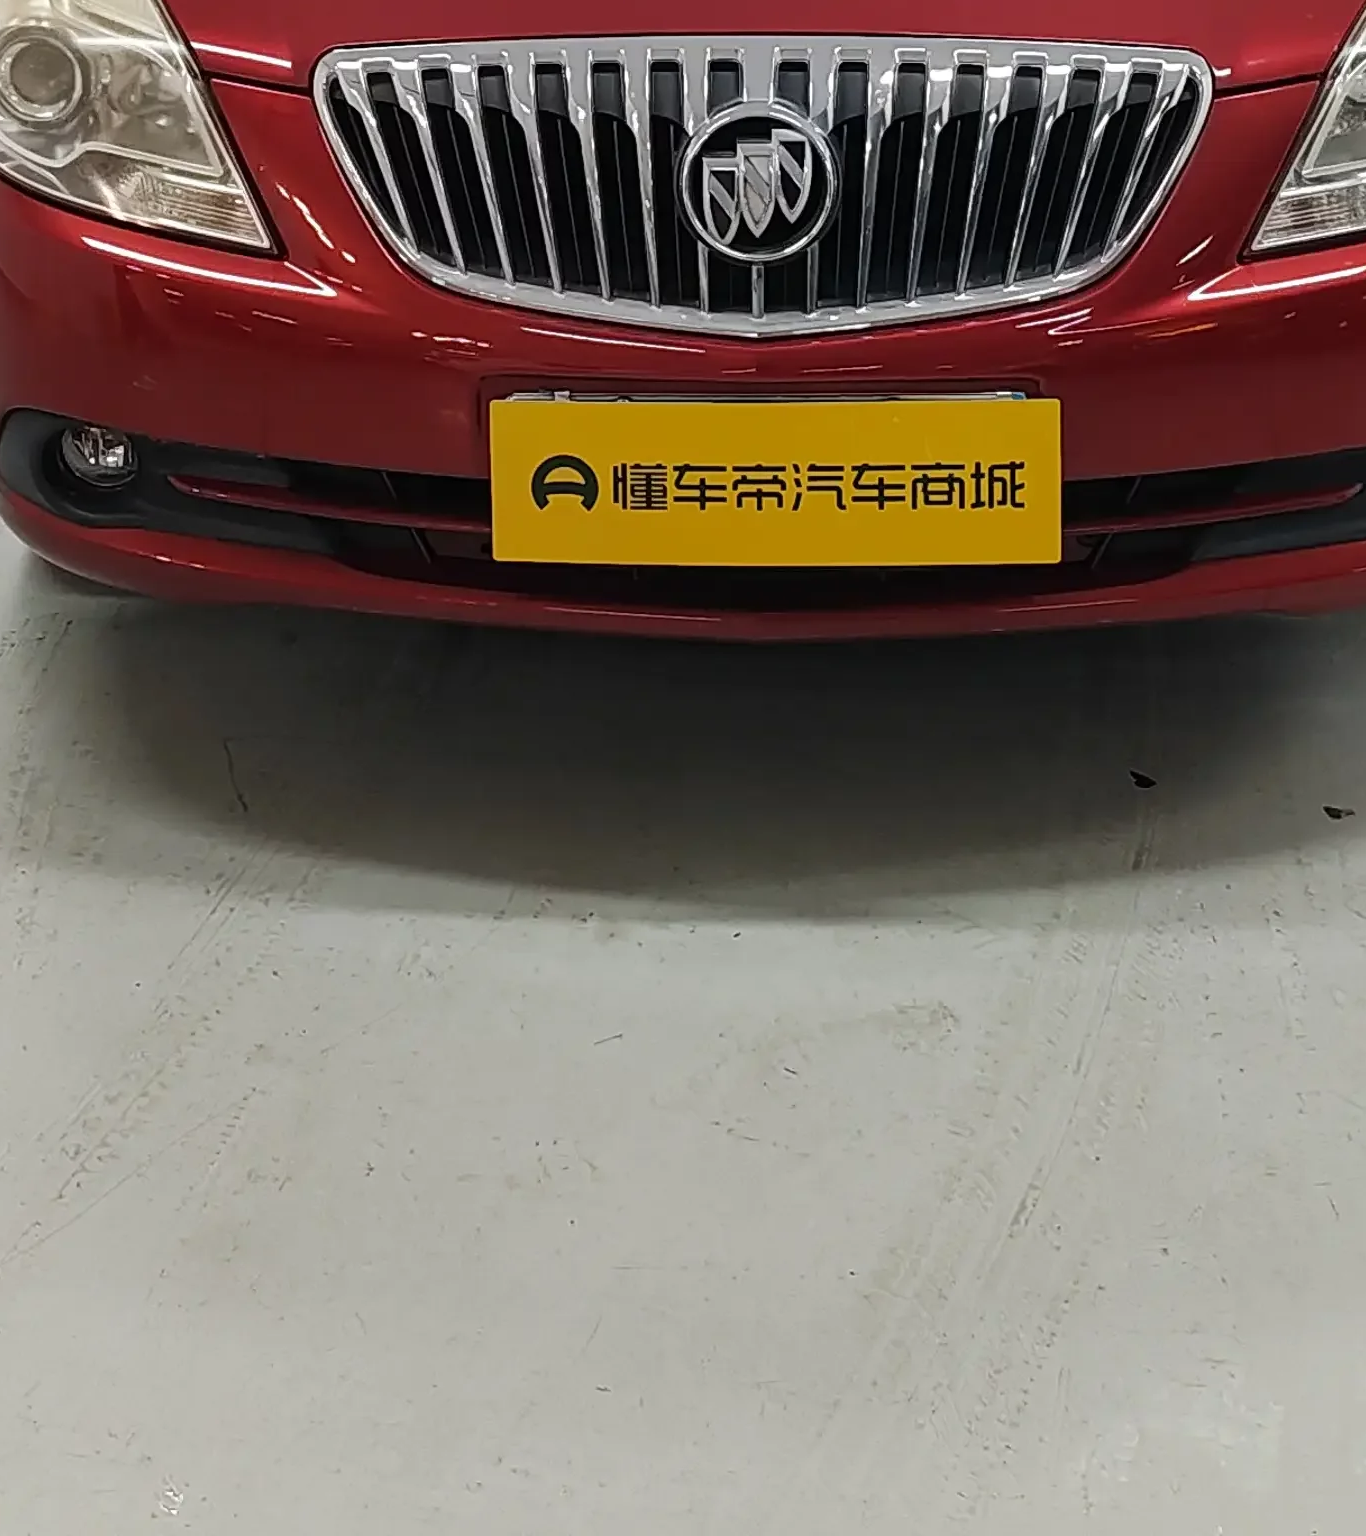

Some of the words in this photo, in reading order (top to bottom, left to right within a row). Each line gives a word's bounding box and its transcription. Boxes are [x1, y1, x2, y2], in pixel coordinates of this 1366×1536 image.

[611, 460, 1026, 512] 懂车帝汽车商城
